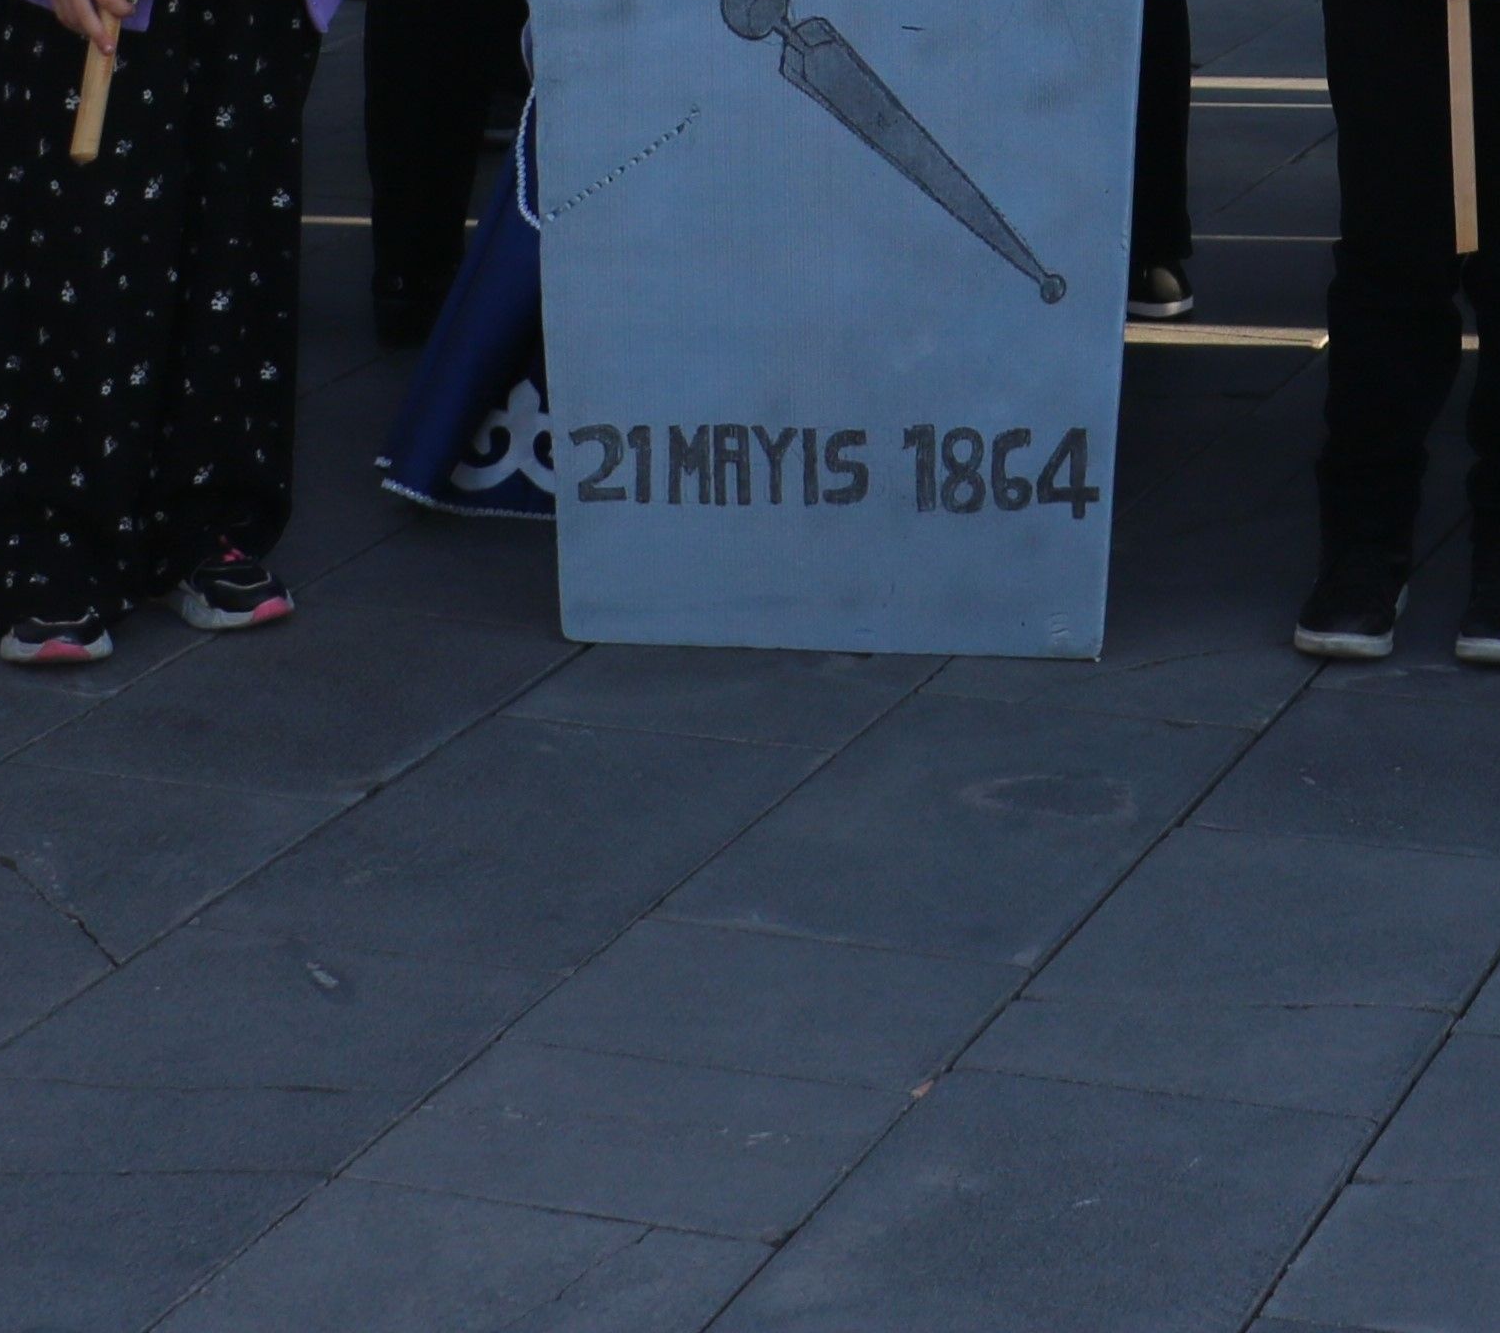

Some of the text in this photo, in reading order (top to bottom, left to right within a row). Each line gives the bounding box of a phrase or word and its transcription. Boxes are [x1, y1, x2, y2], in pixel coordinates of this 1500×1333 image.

[568, 422, 1101, 521] 21 MAYIS 1864
